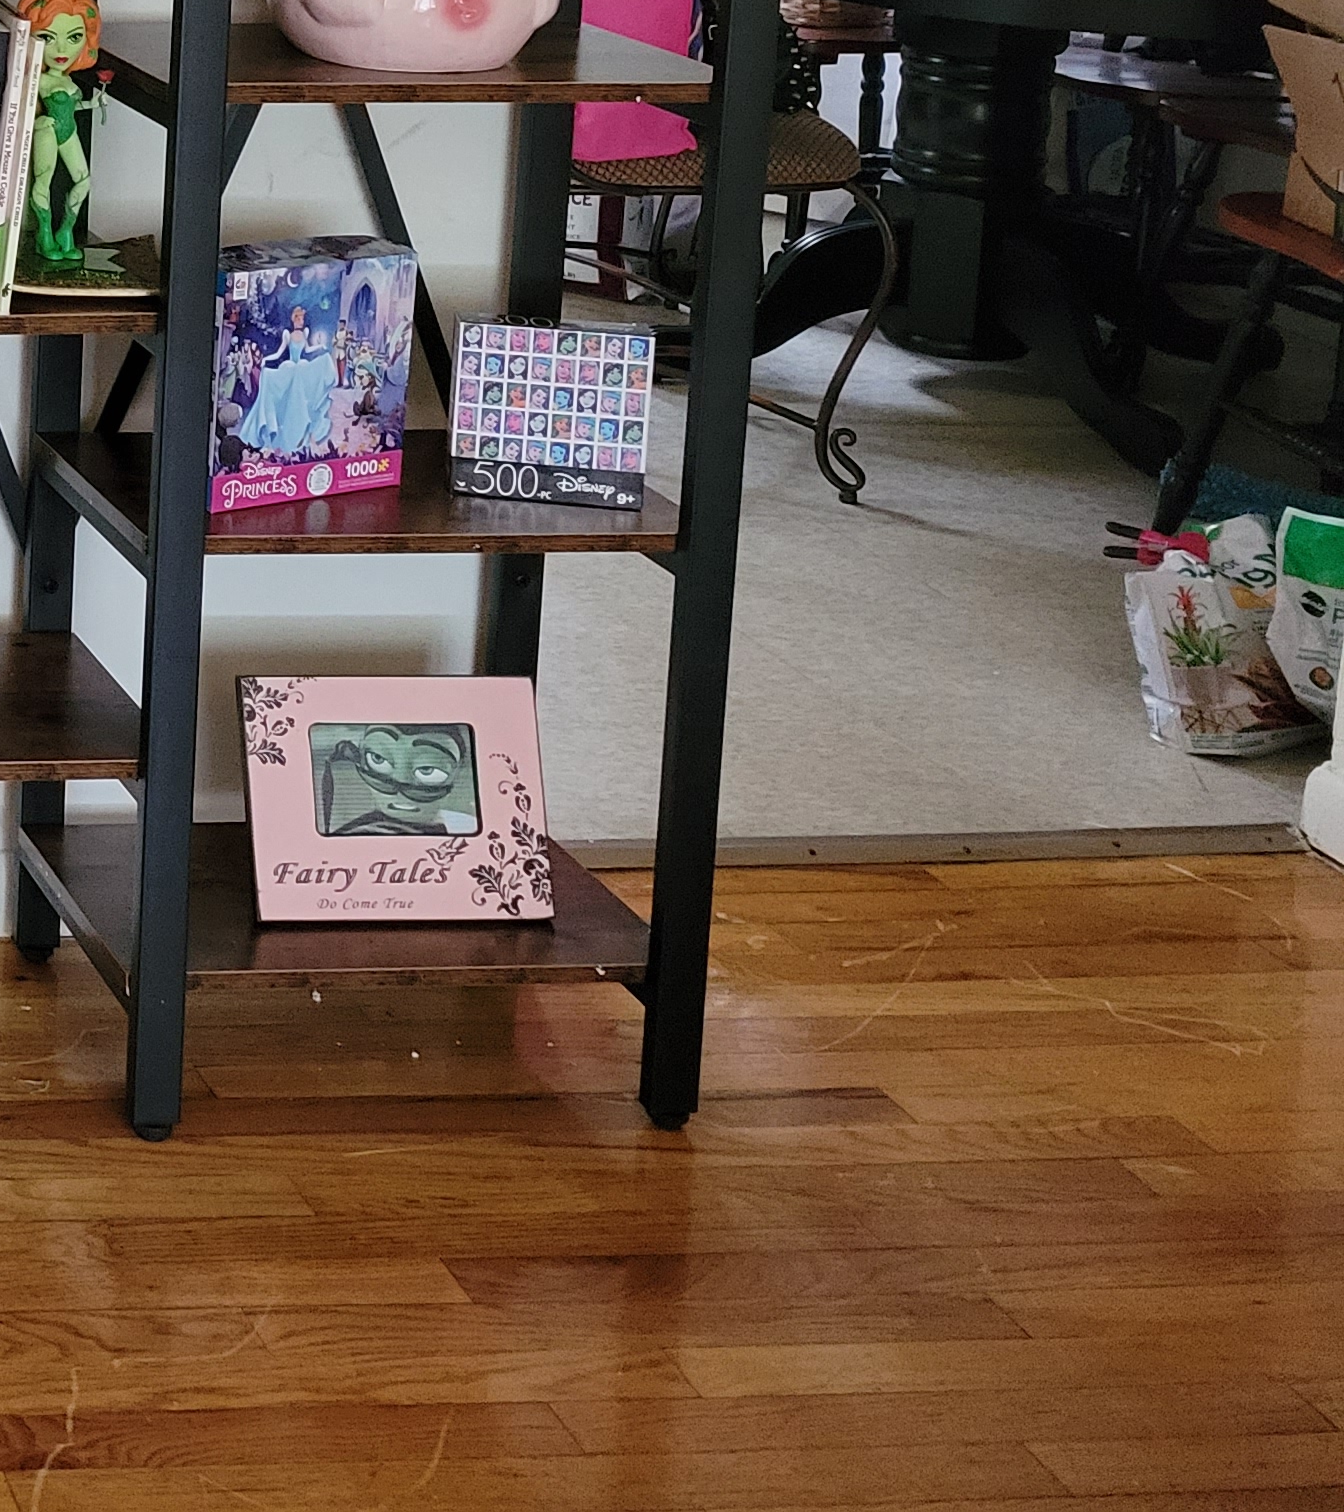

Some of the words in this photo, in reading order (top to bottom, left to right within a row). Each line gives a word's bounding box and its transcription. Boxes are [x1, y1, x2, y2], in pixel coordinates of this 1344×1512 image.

[2, 150, 12, 174] Mouse
[345, 459, 378, 476] 1000
[471, 463, 538, 497] 500
[618, 493, 635, 505] 9+
[273, 861, 357, 892] Fairy
[369, 859, 451, 884] Tales
[316, 898, 337, 909] Do
[343, 898, 378, 909] Come
[384, 899, 414, 909] True
